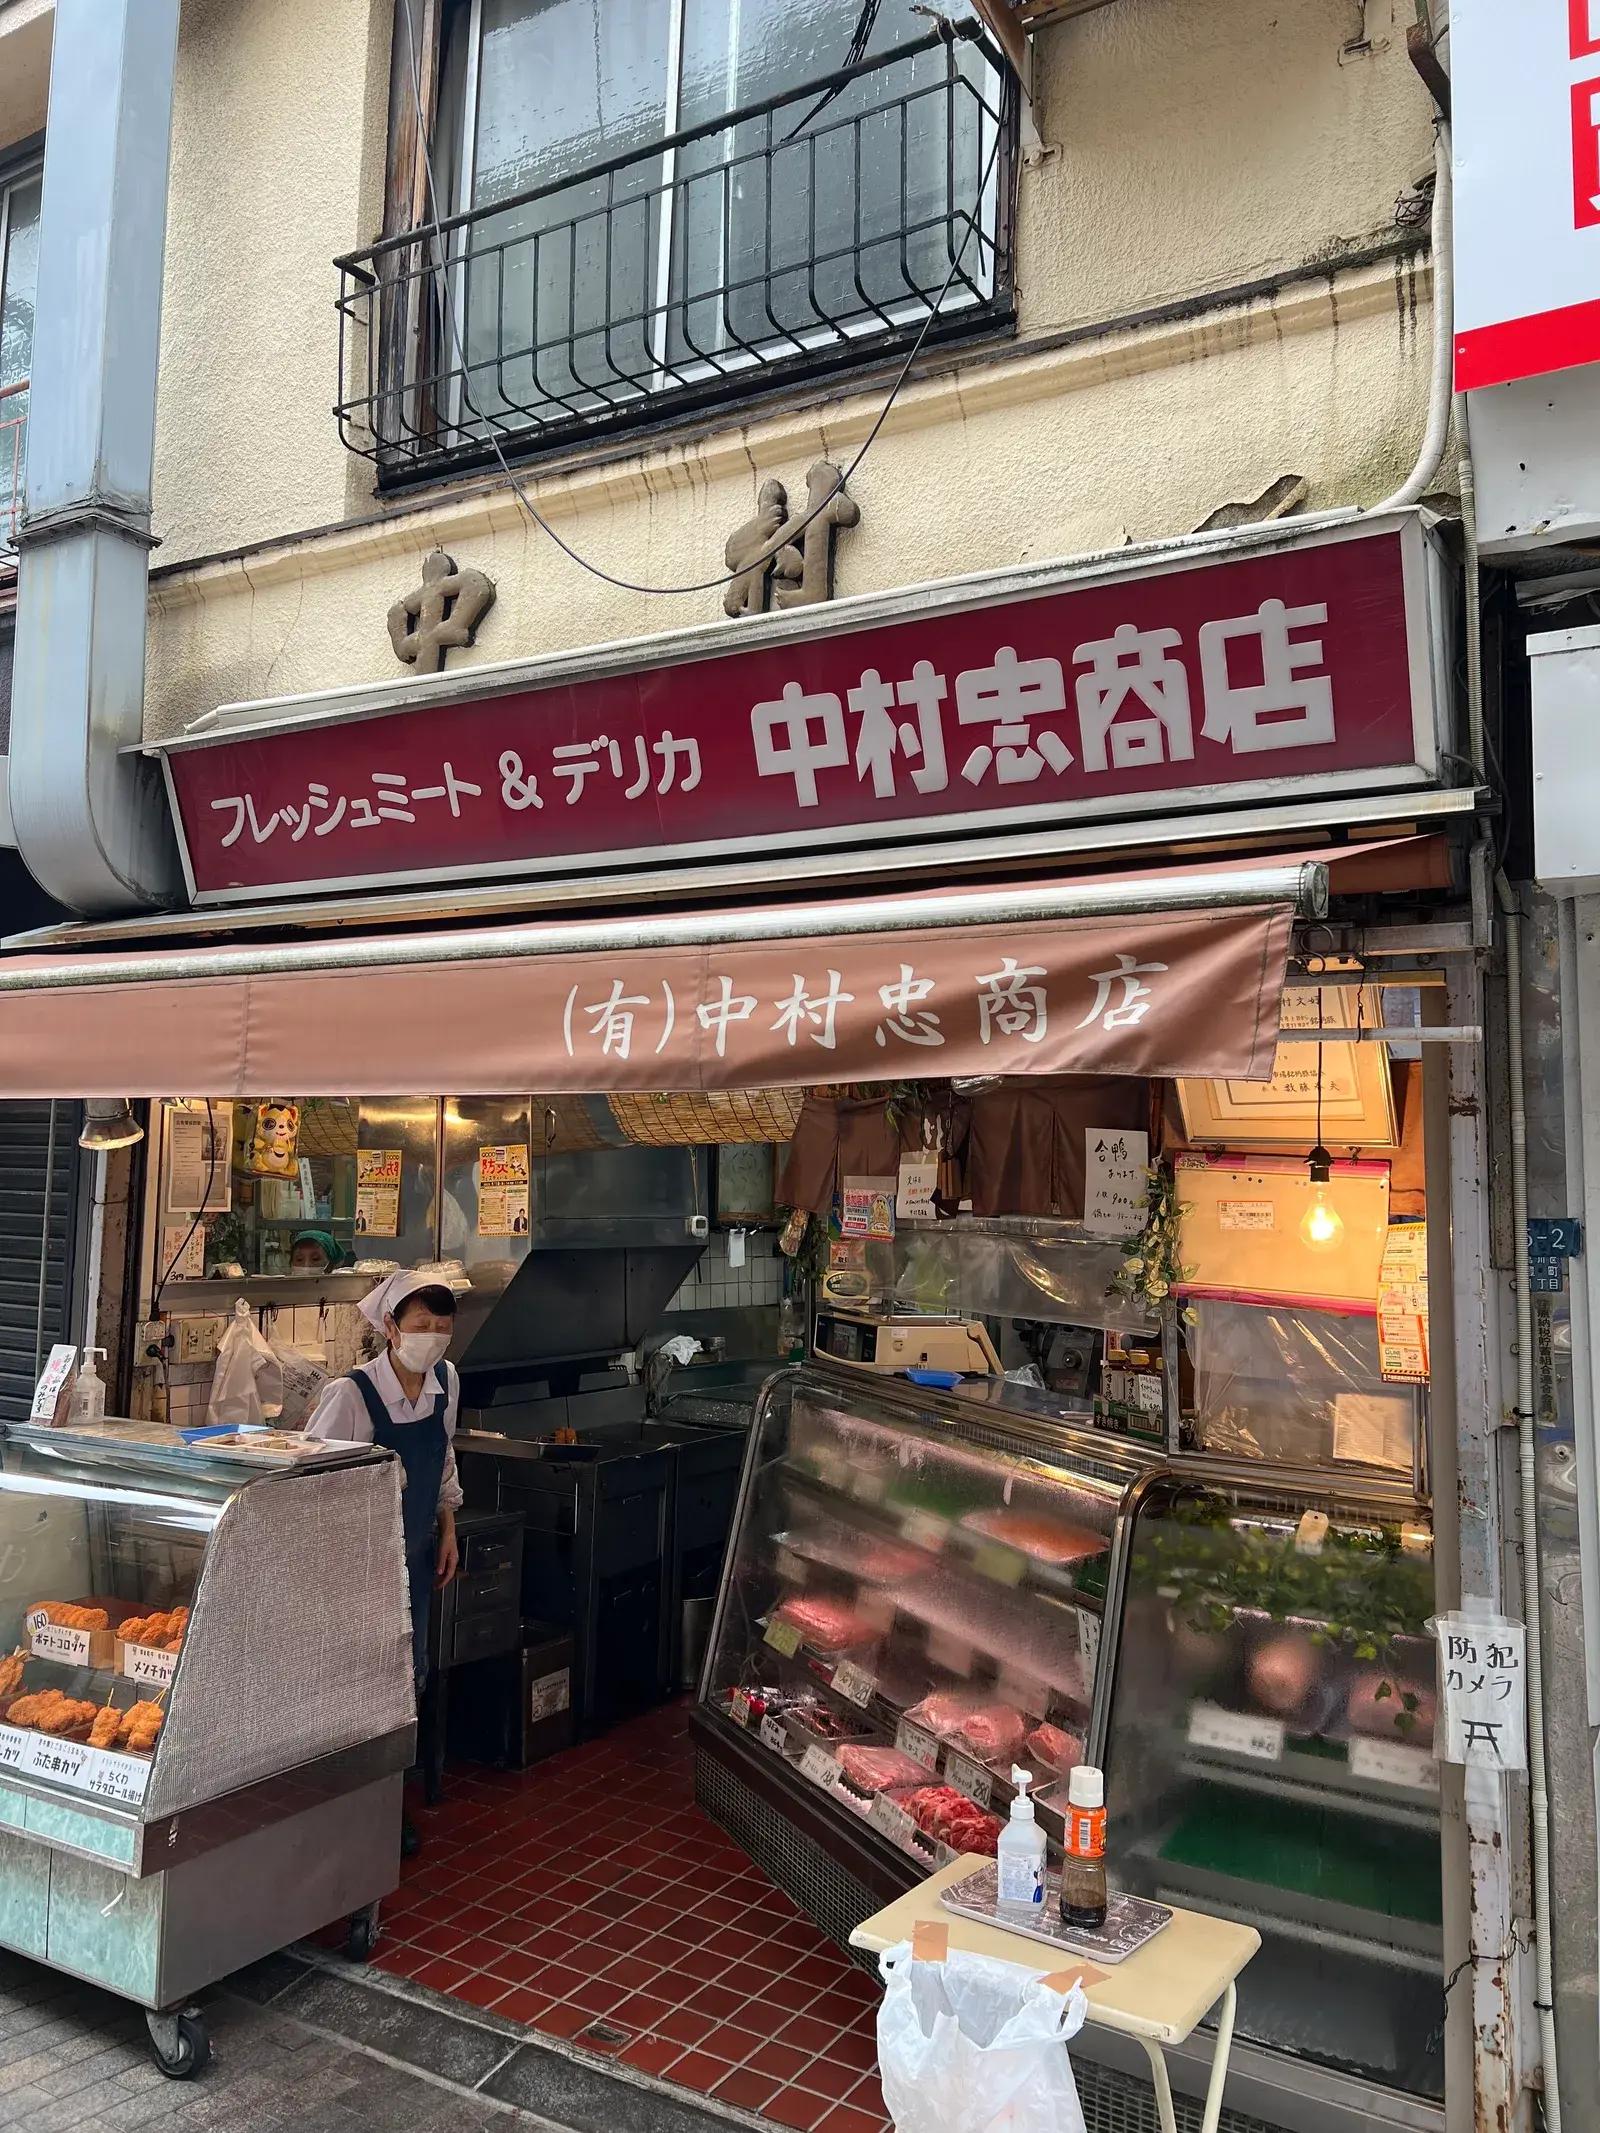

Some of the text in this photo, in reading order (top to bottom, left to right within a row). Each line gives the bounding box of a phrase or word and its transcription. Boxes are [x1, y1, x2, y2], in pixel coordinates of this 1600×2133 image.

[211, 598, 1337, 848] フレッシュミート & デリカ 中村忠商店
[1094, 1137, 1128, 1162] 合鴨
[33, 1612, 47, 1630] 160
[35, 1633, 87, 1653] ポテトコロッケ
[1448, 1635, 1519, 1669] 防犯
[1445, 1669, 1513, 1701] カメラ
[32, 1751, 81, 1777] ぶた串カツ
[108, 1770, 129, 1785] ちくわ
